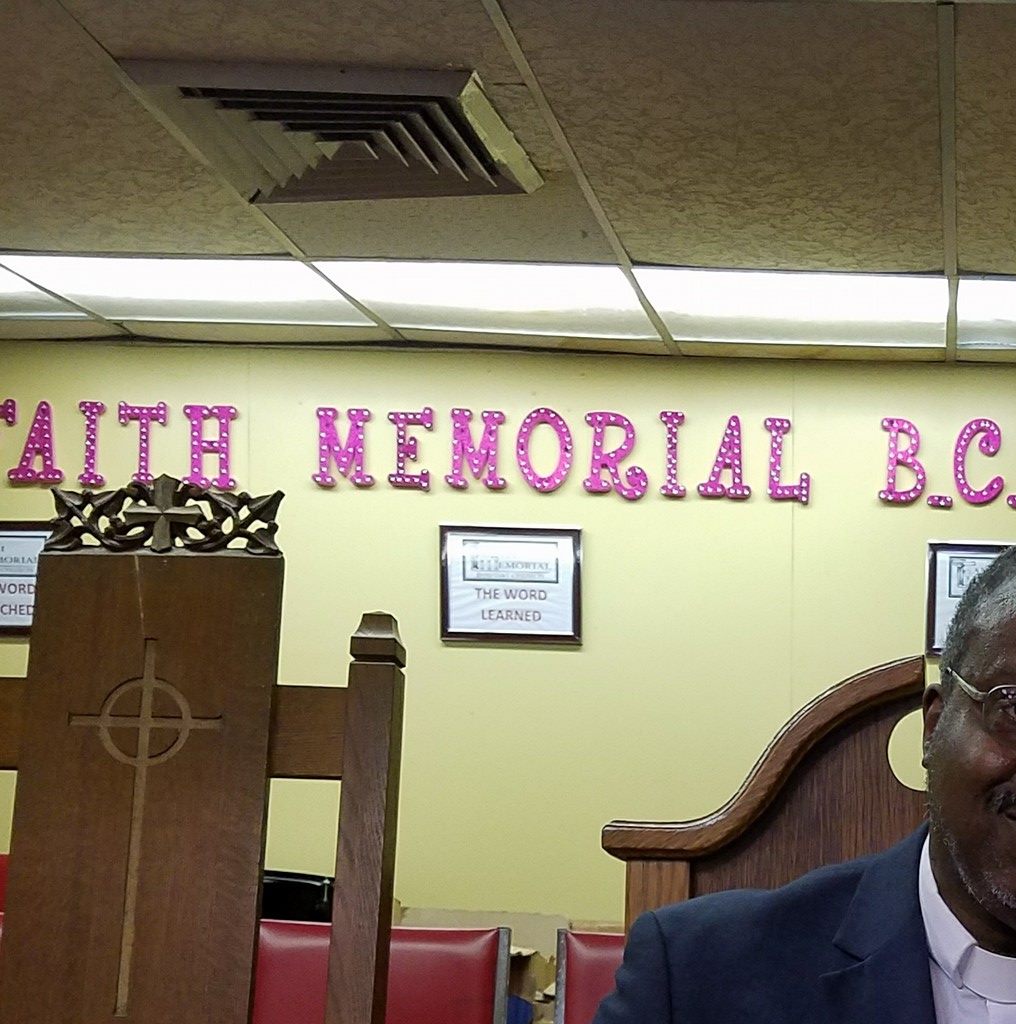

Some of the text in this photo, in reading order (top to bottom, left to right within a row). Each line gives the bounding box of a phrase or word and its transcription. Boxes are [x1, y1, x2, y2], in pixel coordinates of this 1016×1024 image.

[312, 406, 810, 505] MEMORIAL
[474, 587, 548, 601] THE WORD
[481, 609, 542, 622] LEARNED
